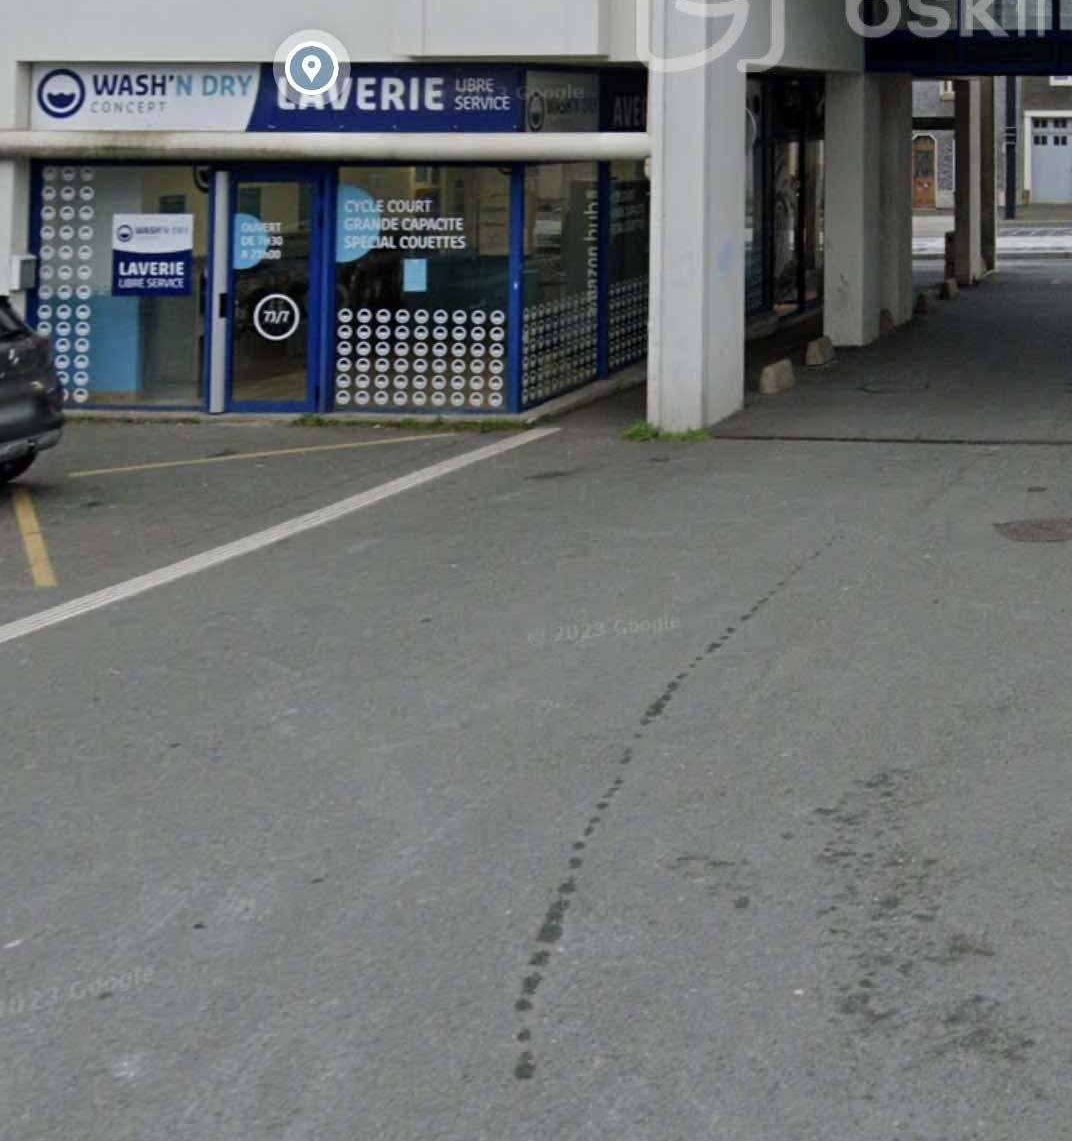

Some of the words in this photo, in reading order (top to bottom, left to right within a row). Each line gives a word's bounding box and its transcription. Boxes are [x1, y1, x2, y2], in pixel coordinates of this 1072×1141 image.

[93, 74, 193, 96] WASH'N
[202, 74, 253, 96] DRY
[455, 77, 494, 92] LIBRE
[90, 101, 167, 114] CONCEPT
[455, 95, 511, 110] SERVICE
[344, 200, 384, 212] CYCLE
[387, 200, 432, 213] COURT
[344, 218, 398, 231] GRANDE
[402, 218, 464, 231] CAPACITE
[344, 236, 397, 249] SPECIAL
[400, 236, 466, 249] COUETTES
[119, 261, 184, 276] LAVERIE
[147, 277, 184, 289] SERVICE
